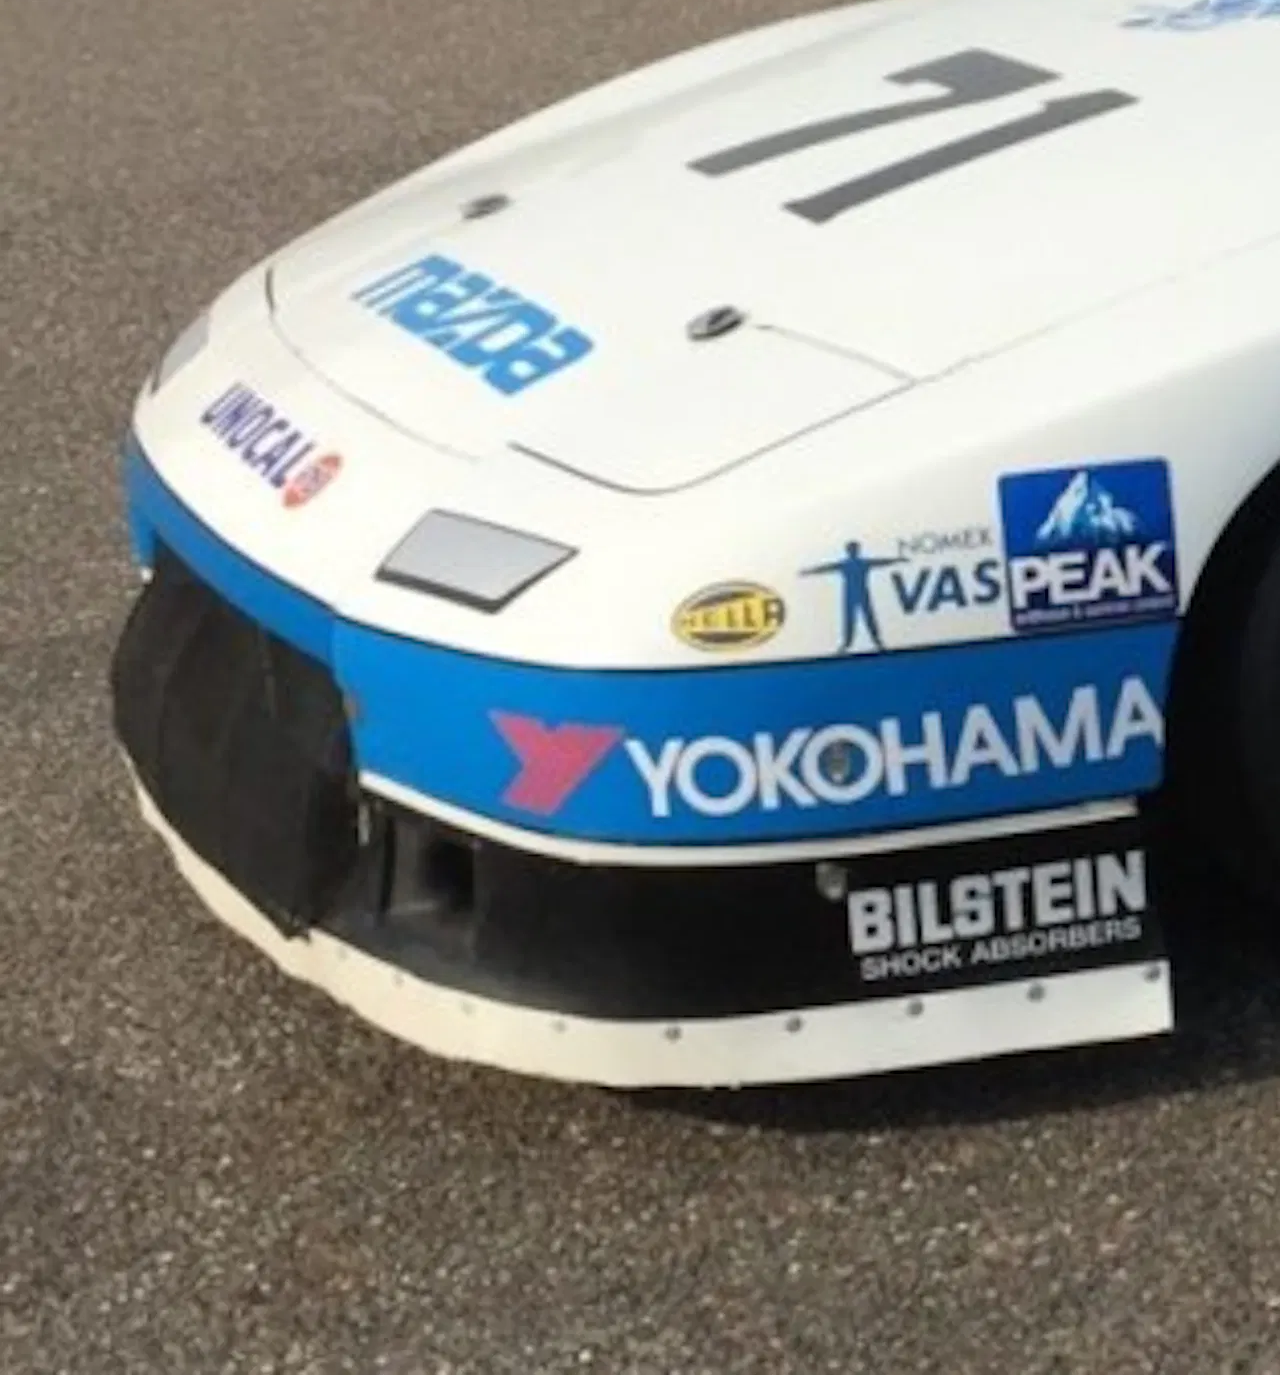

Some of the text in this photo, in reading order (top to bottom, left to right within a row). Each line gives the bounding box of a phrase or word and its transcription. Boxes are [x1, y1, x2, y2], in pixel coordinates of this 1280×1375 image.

[686, 47, 1140, 225] 71
[201, 382, 316, 489] UNOCAL
[1009, 540, 1172, 610] PEAK
[622, 675, 1165, 818] YOKOHAMA
[847, 850, 1147, 954] BILSTEIN
[860, 916, 1142, 982] SHOCK ABSORBERS
